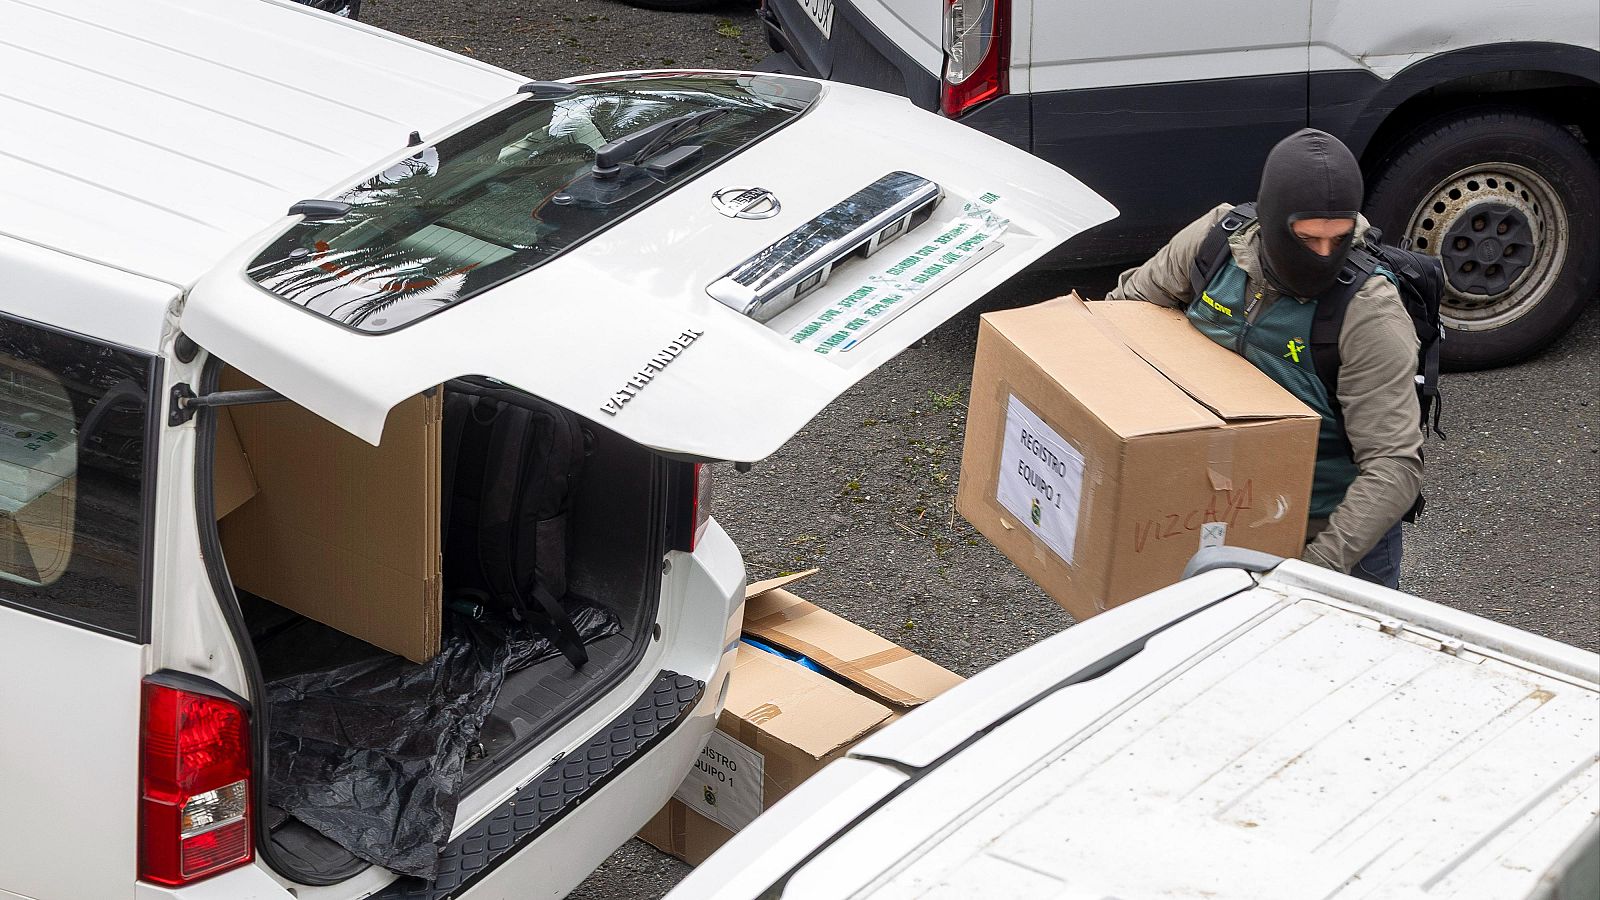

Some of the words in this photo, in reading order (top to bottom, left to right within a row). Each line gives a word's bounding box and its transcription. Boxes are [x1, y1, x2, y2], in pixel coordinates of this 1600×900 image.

[600, 328, 704, 416] PATHFINDER
[1020, 427, 1066, 479] REGISTRO
[1018, 458, 1054, 502] EQUIPO
[1055, 493, 1062, 511] 1
[728, 777, 733, 787] 1
